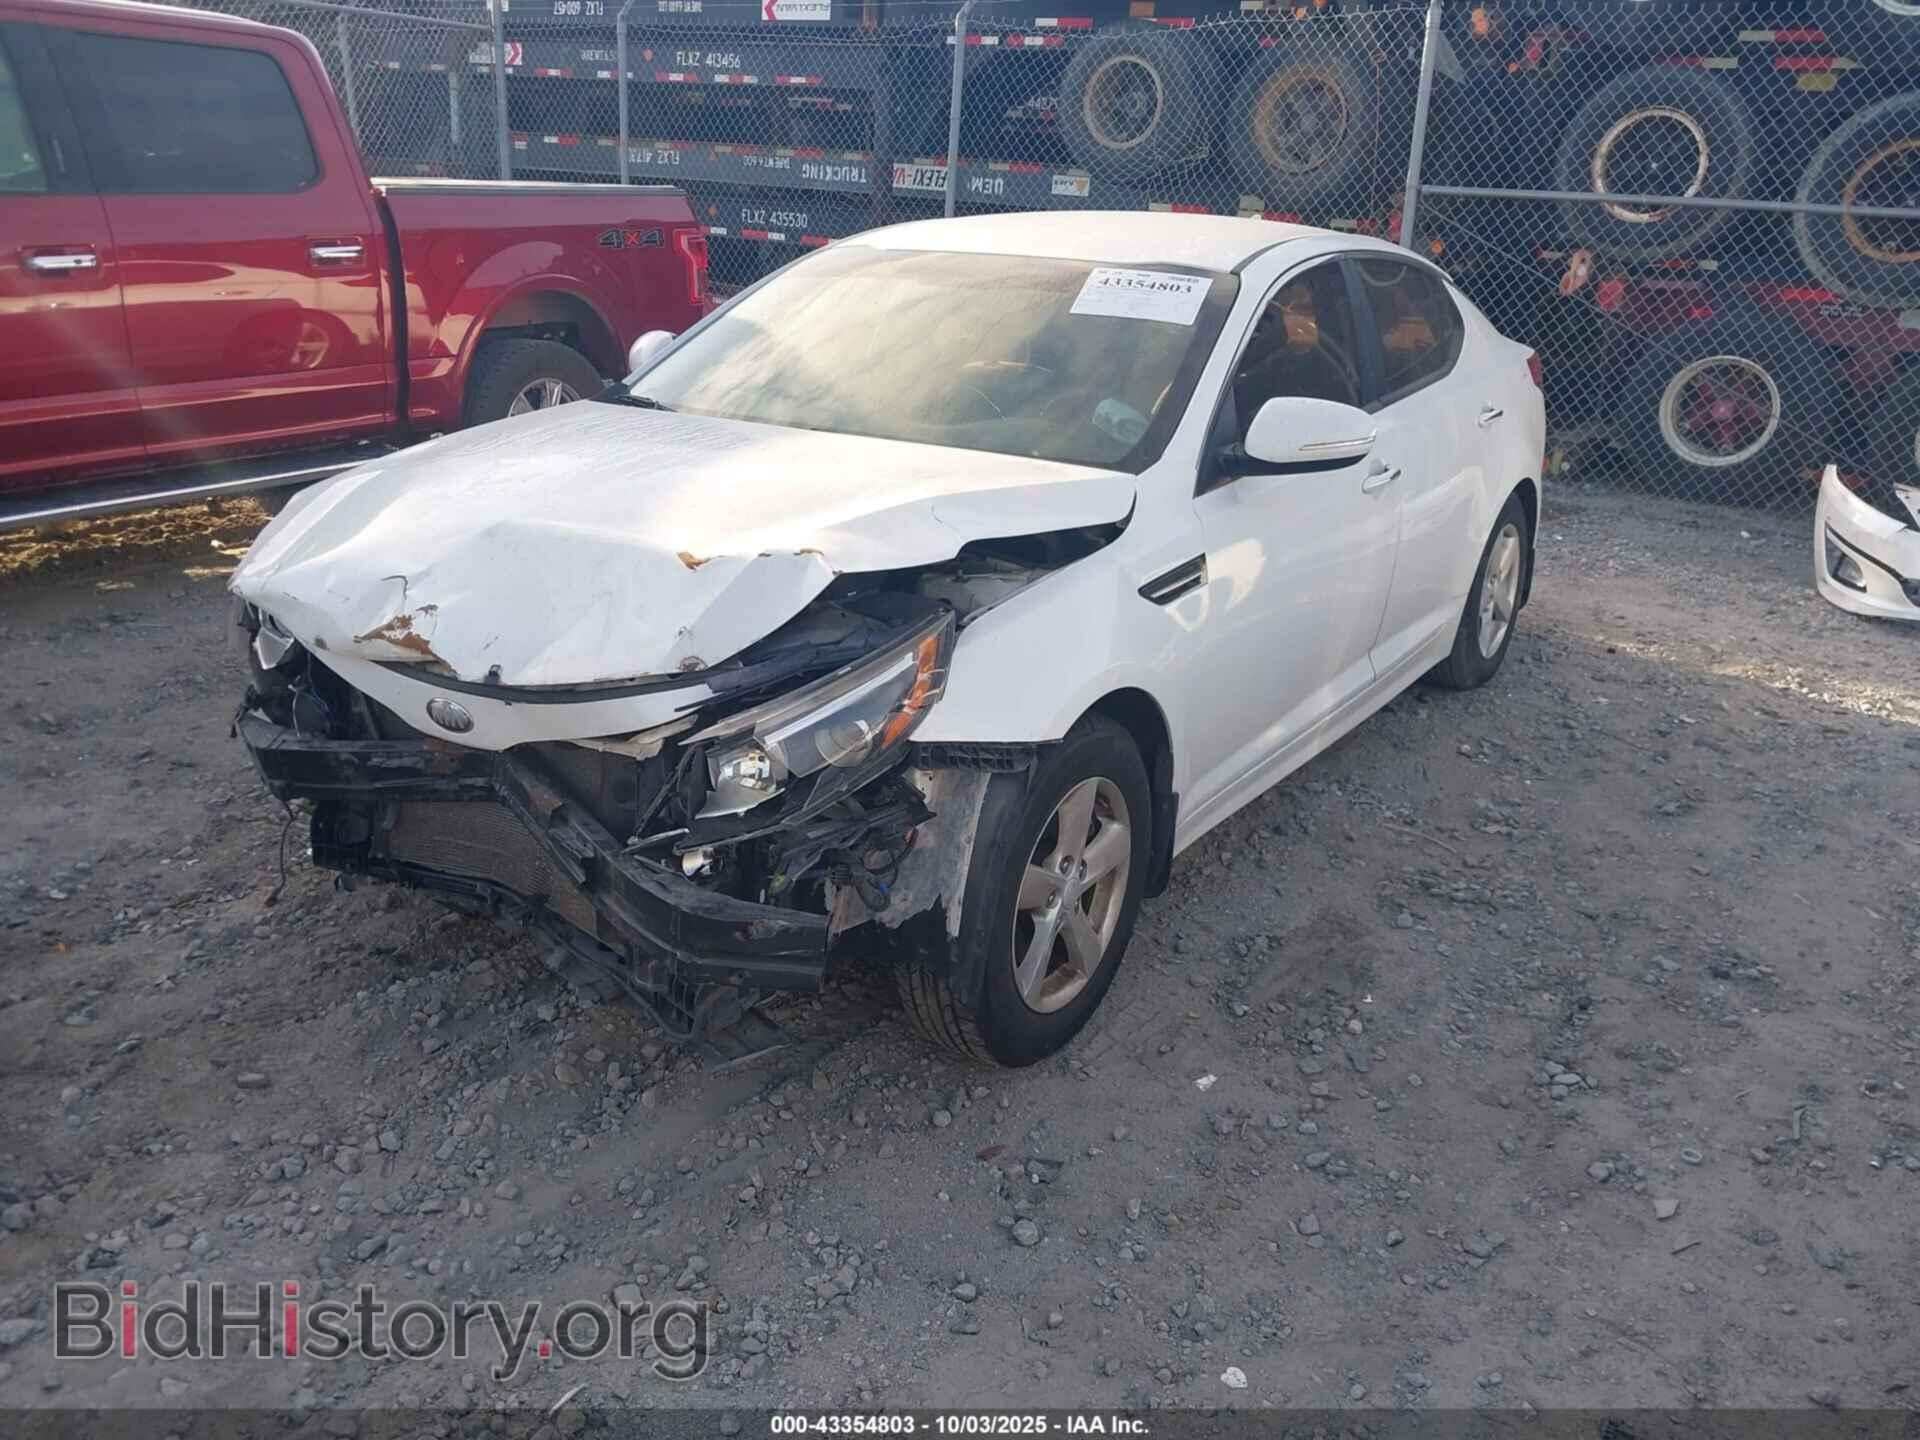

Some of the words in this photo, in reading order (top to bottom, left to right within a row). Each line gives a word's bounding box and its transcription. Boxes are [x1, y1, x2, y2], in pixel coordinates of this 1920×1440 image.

[585, 1, 604, 15] FLXZ
[676, 51, 700, 66] FLXZ
[706, 53, 741, 68] 413456
[658, 150, 680, 165] FLXZ
[802, 163, 867, 183] TRUCKING
[742, 208, 766, 224] FLXZ
[769, 212, 808, 228] 435530
[1098, 276, 1193, 294] 43354803
